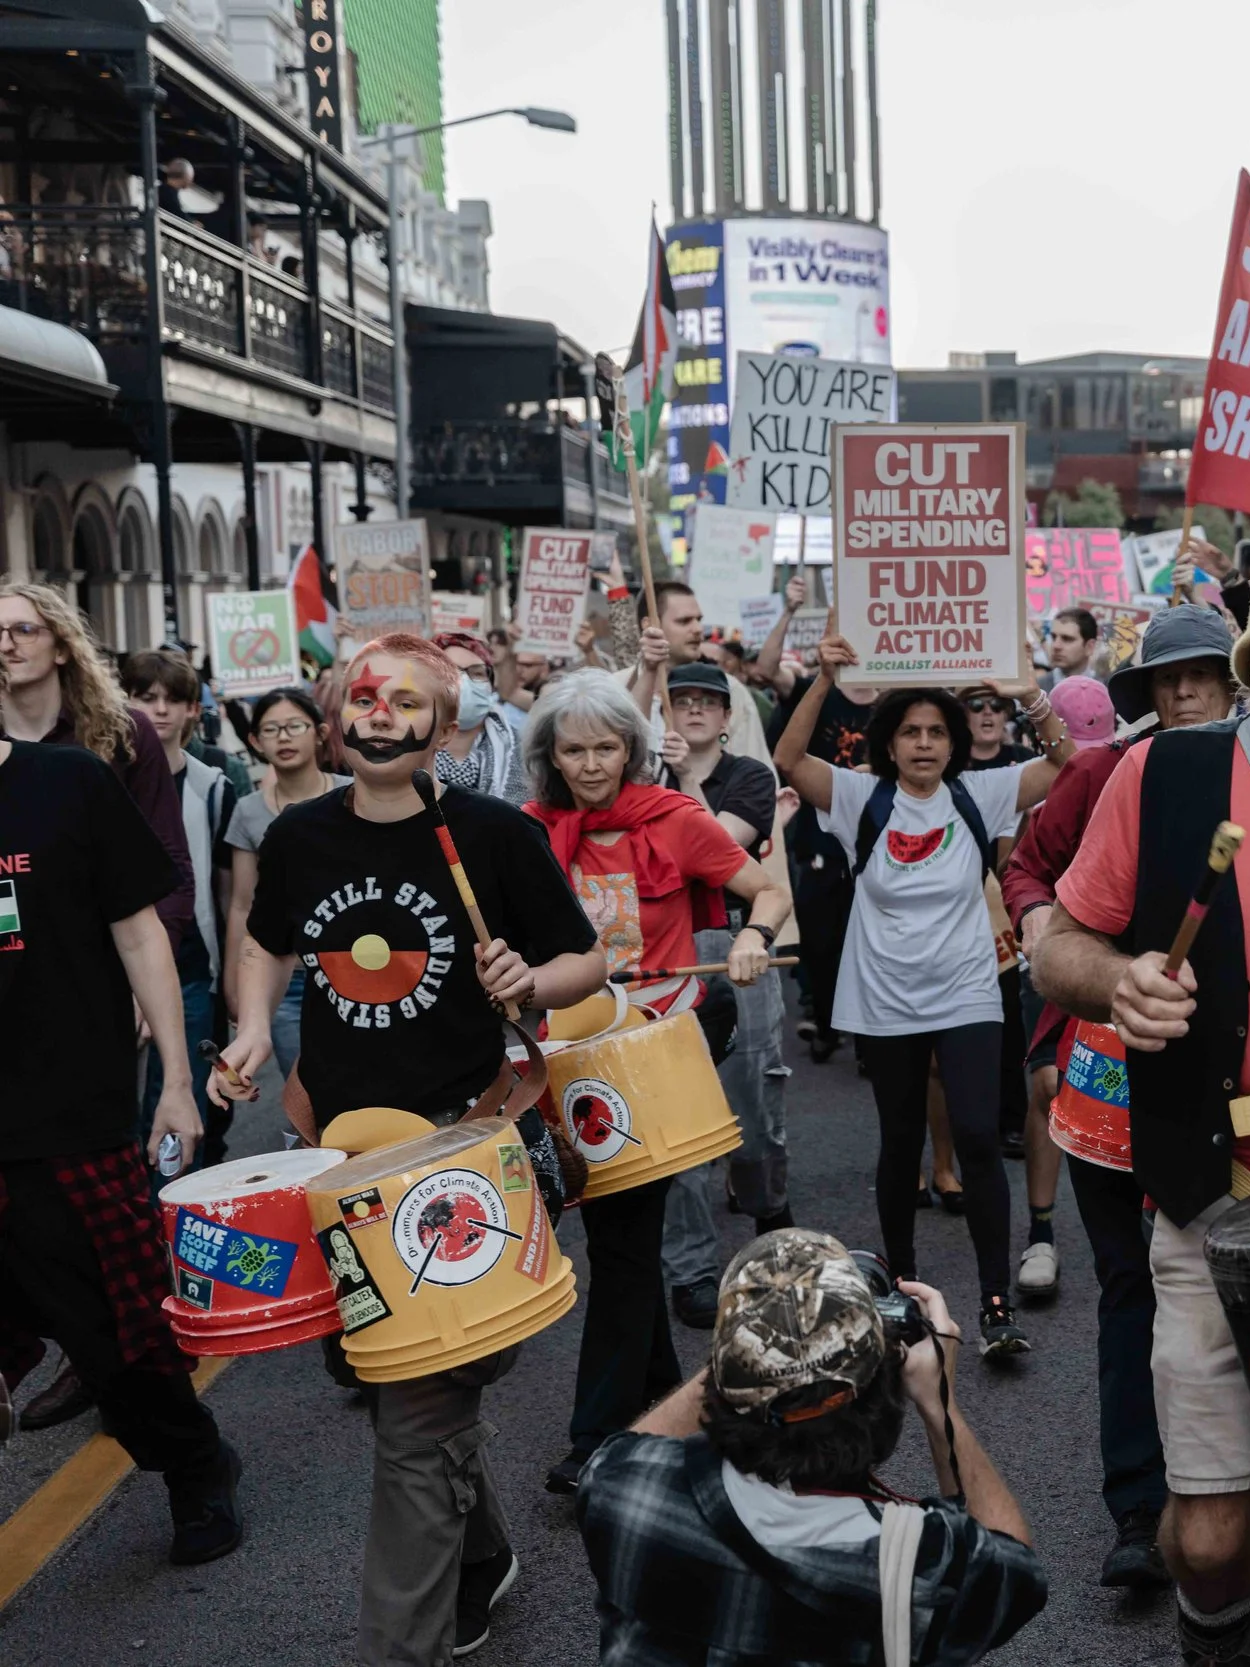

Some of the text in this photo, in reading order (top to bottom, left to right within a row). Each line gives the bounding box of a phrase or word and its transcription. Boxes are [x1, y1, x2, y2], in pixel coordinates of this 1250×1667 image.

[748, 263, 880, 290] in 1 Week
[748, 360, 889, 413] YOU ARE
[748, 412, 832, 457] KILLI
[875, 442, 980, 486] CUT
[760, 460, 832, 508] KID
[854, 487, 1002, 517] MILITARY
[848, 518, 1007, 549] SPENDING
[540, 538, 583, 562] CUT
[347, 571, 421, 609] STOP
[868, 560, 988, 599] FUND
[530, 595, 574, 614] FUND
[867, 601, 989, 627] CLIMATE
[218, 613, 275, 632] WAR
[529, 629, 569, 640] ACTION
[874, 628, 983, 655] ACTION
[932, 658, 993, 670] ALLIANCE
[302, 877, 456, 1029] STILL STANDING STRONG
[1072, 1041, 1095, 1066] SAVE
[584, 1084, 613, 1101] Climate
[612, 1101, 624, 1128] Action
[182, 1216, 228, 1246] SAVE
[403, 1197, 421, 1258] Drmmers
[418, 1183, 437, 1200] for
[481, 1189, 499, 1225] Action
[178, 1241, 219, 1272] REEF
[180, 1231, 222, 1258] SCOTT
[522, 1242, 537, 1275] END
